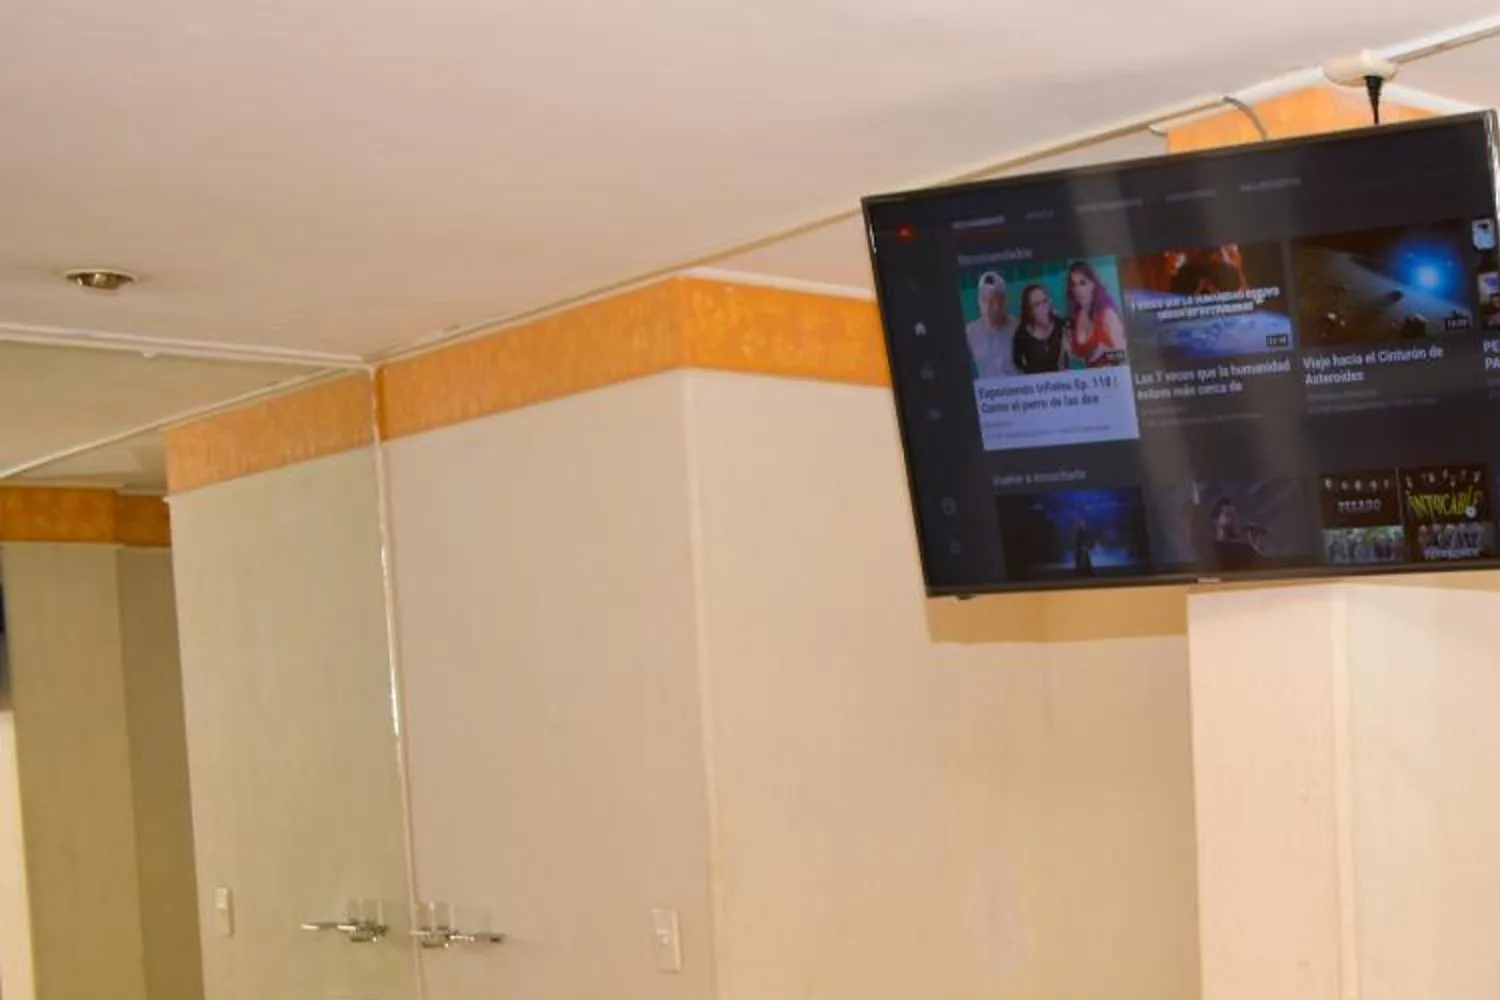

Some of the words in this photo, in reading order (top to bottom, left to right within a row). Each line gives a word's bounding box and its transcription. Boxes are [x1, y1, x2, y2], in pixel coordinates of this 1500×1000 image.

[1303, 357, 1331, 371] Viaje
[1332, 352, 1363, 367] hacia
[1365, 353, 1377, 364] el
[1378, 345, 1427, 364] Cinturón
[1428, 344, 1444, 358] de
[1197, 368, 1217, 382] que
[1218, 363, 1229, 377] la
[1230, 357, 1291, 376] humanidad
[1305, 370, 1365, 385] Asteroides
[1229, 379, 1243, 393] de
[981, 401, 1010, 414] Como
[1012, 399, 1021, 411] el
[1022, 399, 1048, 414] perro
[1050, 396, 1062, 408] de
